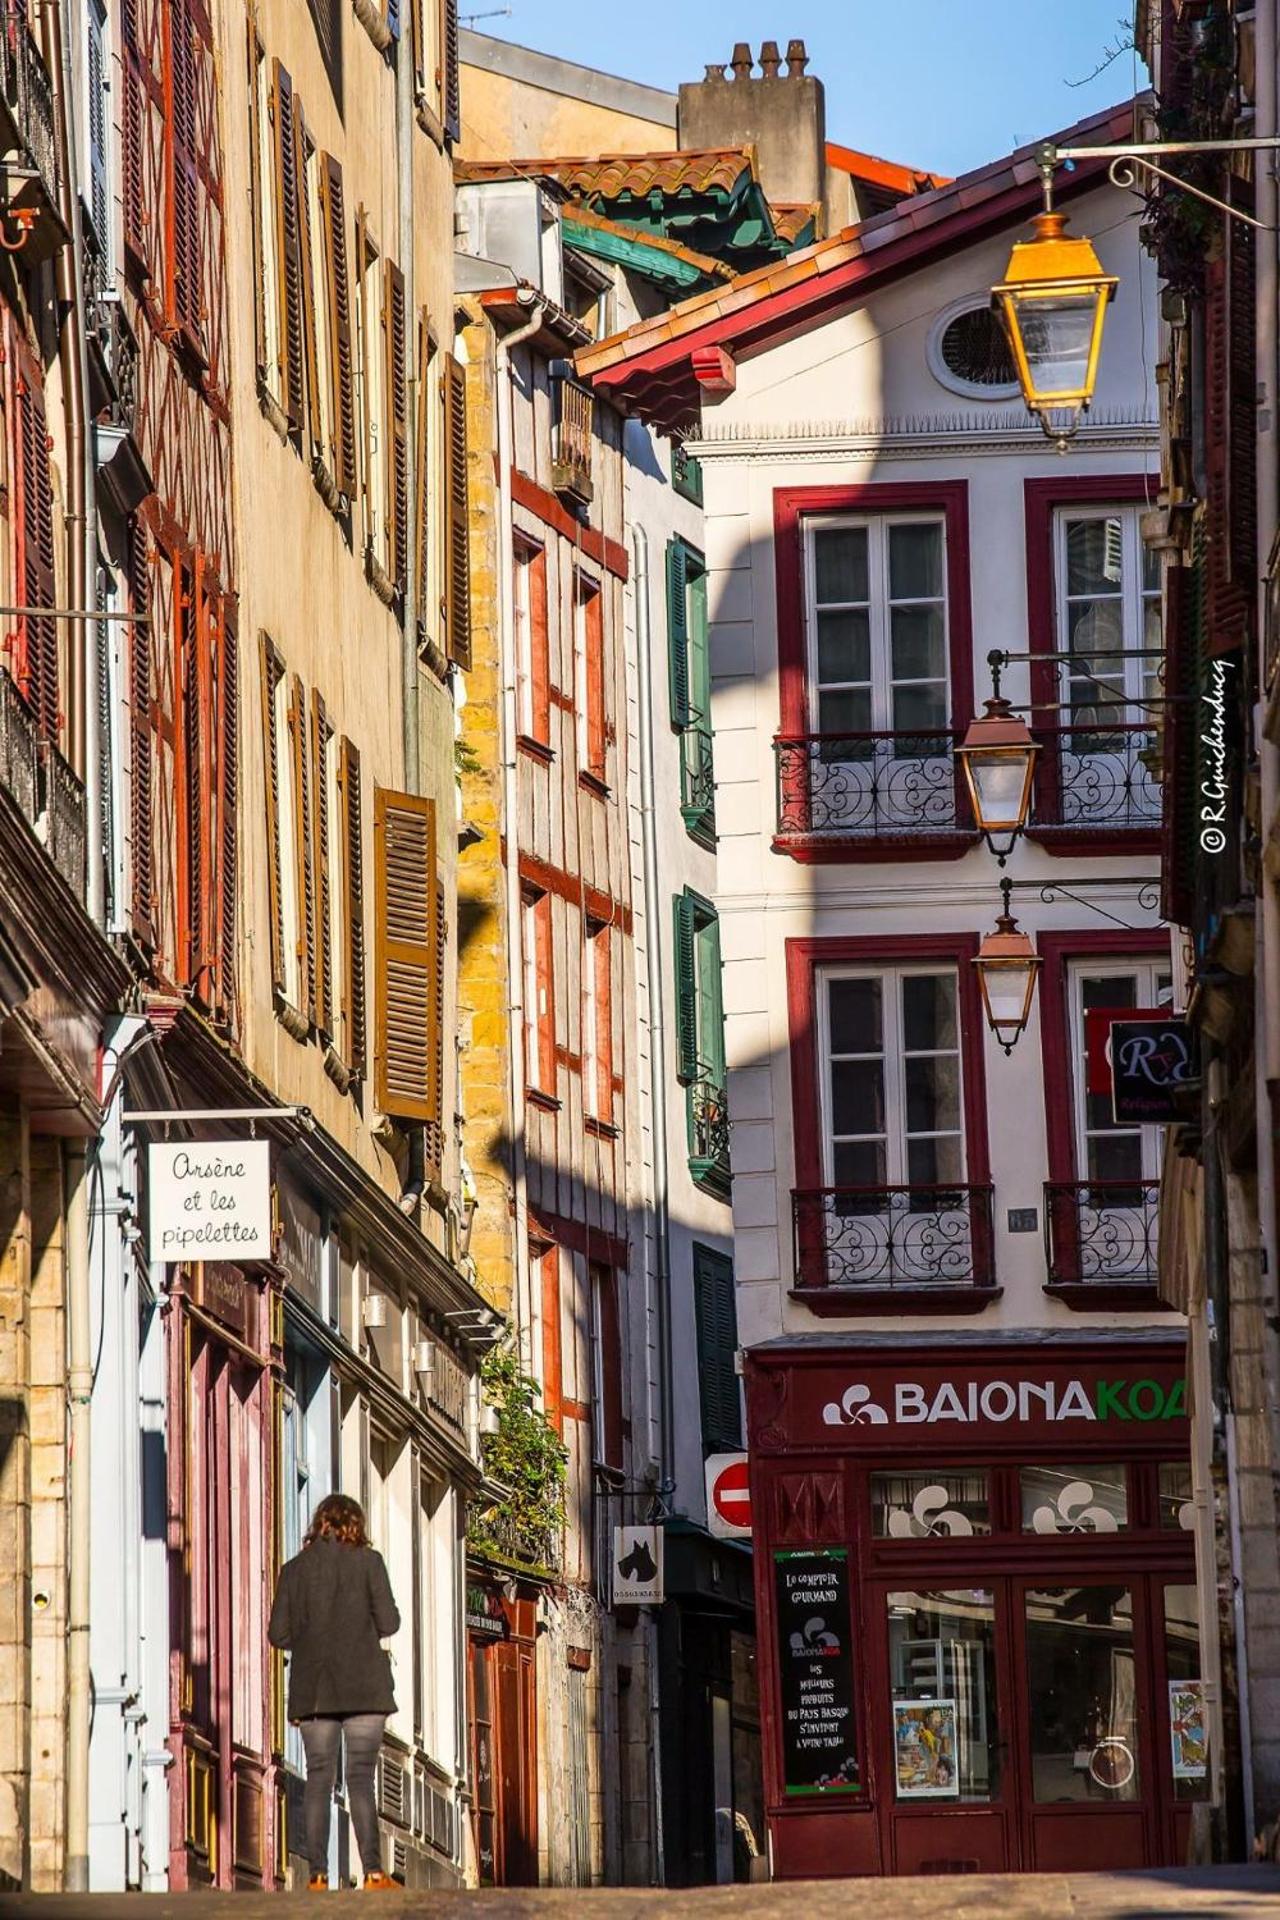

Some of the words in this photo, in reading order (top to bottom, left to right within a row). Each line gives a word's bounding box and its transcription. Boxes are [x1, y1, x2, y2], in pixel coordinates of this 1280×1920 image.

[173, 1152, 246, 1180] Arsène
[184, 1191, 202, 1211] et
[210, 1190, 236, 1210] les
[162, 1222, 258, 1249] pipelettes
[800, 1708, 819, 1719] PAYS
